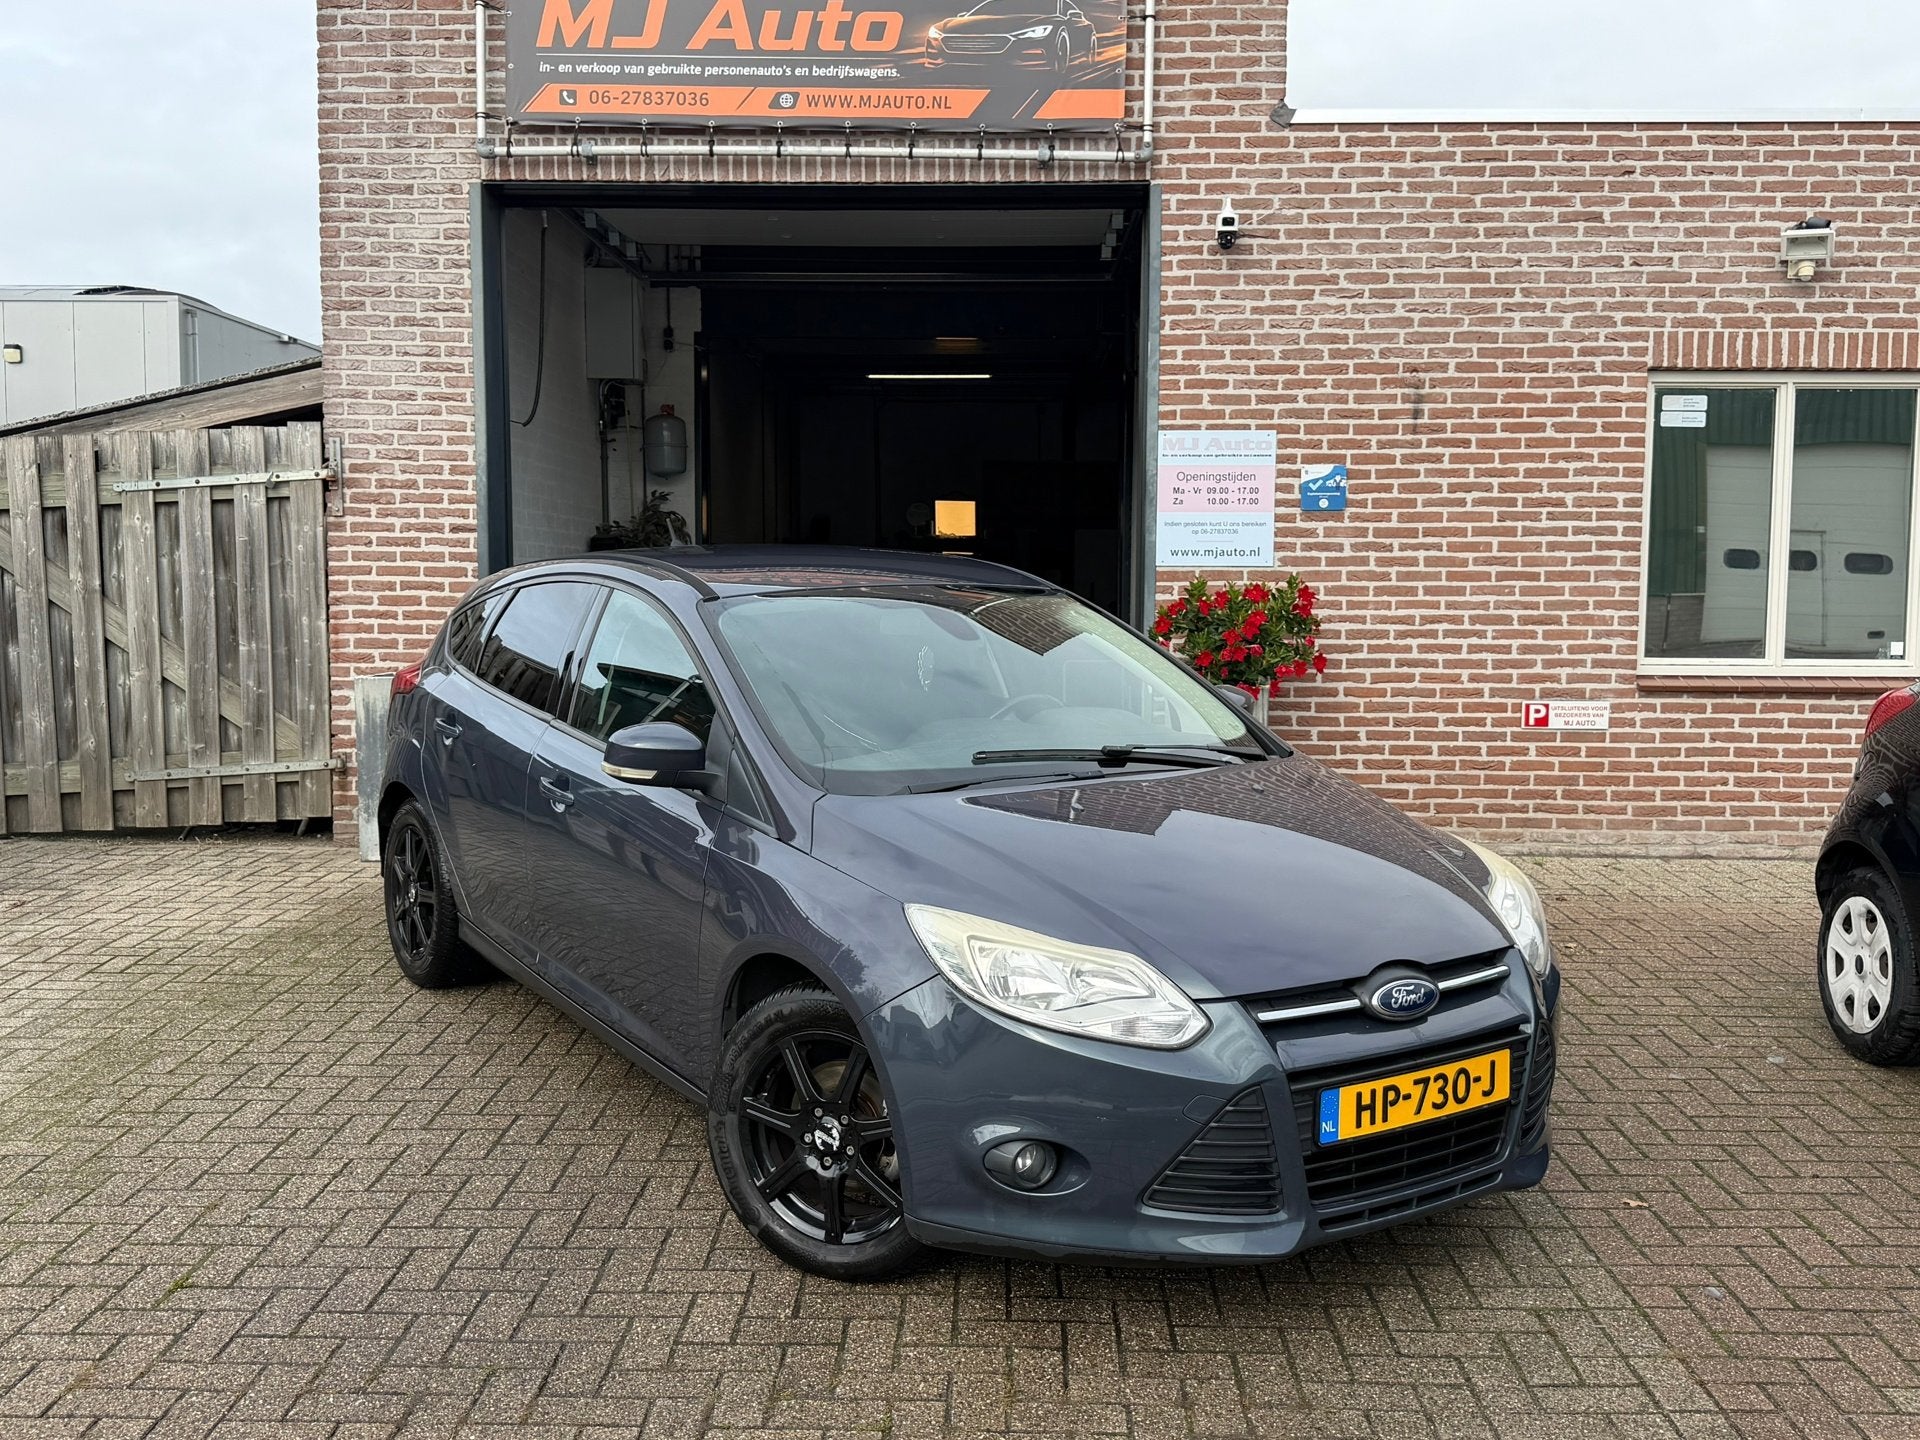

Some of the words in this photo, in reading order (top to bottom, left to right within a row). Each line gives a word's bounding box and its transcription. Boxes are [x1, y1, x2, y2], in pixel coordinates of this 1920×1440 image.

[536, 0, 668, 48] MJ
[685, 0, 904, 51] Auto
[539, 61, 555, 72] in-
[558, 64, 573, 73] en
[576, 62, 621, 75] verkoop
[624, 65, 645, 74] van
[647, 63, 702, 76] gebruikte
[704, 65, 792, 77] personenauto's
[794, 67, 809, 76] en
[812, 65, 901, 80] bedrijfswagens.
[589, 90, 710, 106] 06-27837036
[806, 94, 952, 109] WWW.MJAUTO.NL
[1162, 437, 1199, 450] MJ
[1204, 437, 1273, 450] Auto
[1176, 471, 1256, 484] Openingstijden
[1170, 546, 1261, 559] www.mjauto.nl
[1528, 704, 1547, 726] P
[1391, 984, 1426, 1008] Ford
[1355, 1059, 1497, 1130] HP-730-J
[1321, 1121, 1336, 1134] NL
